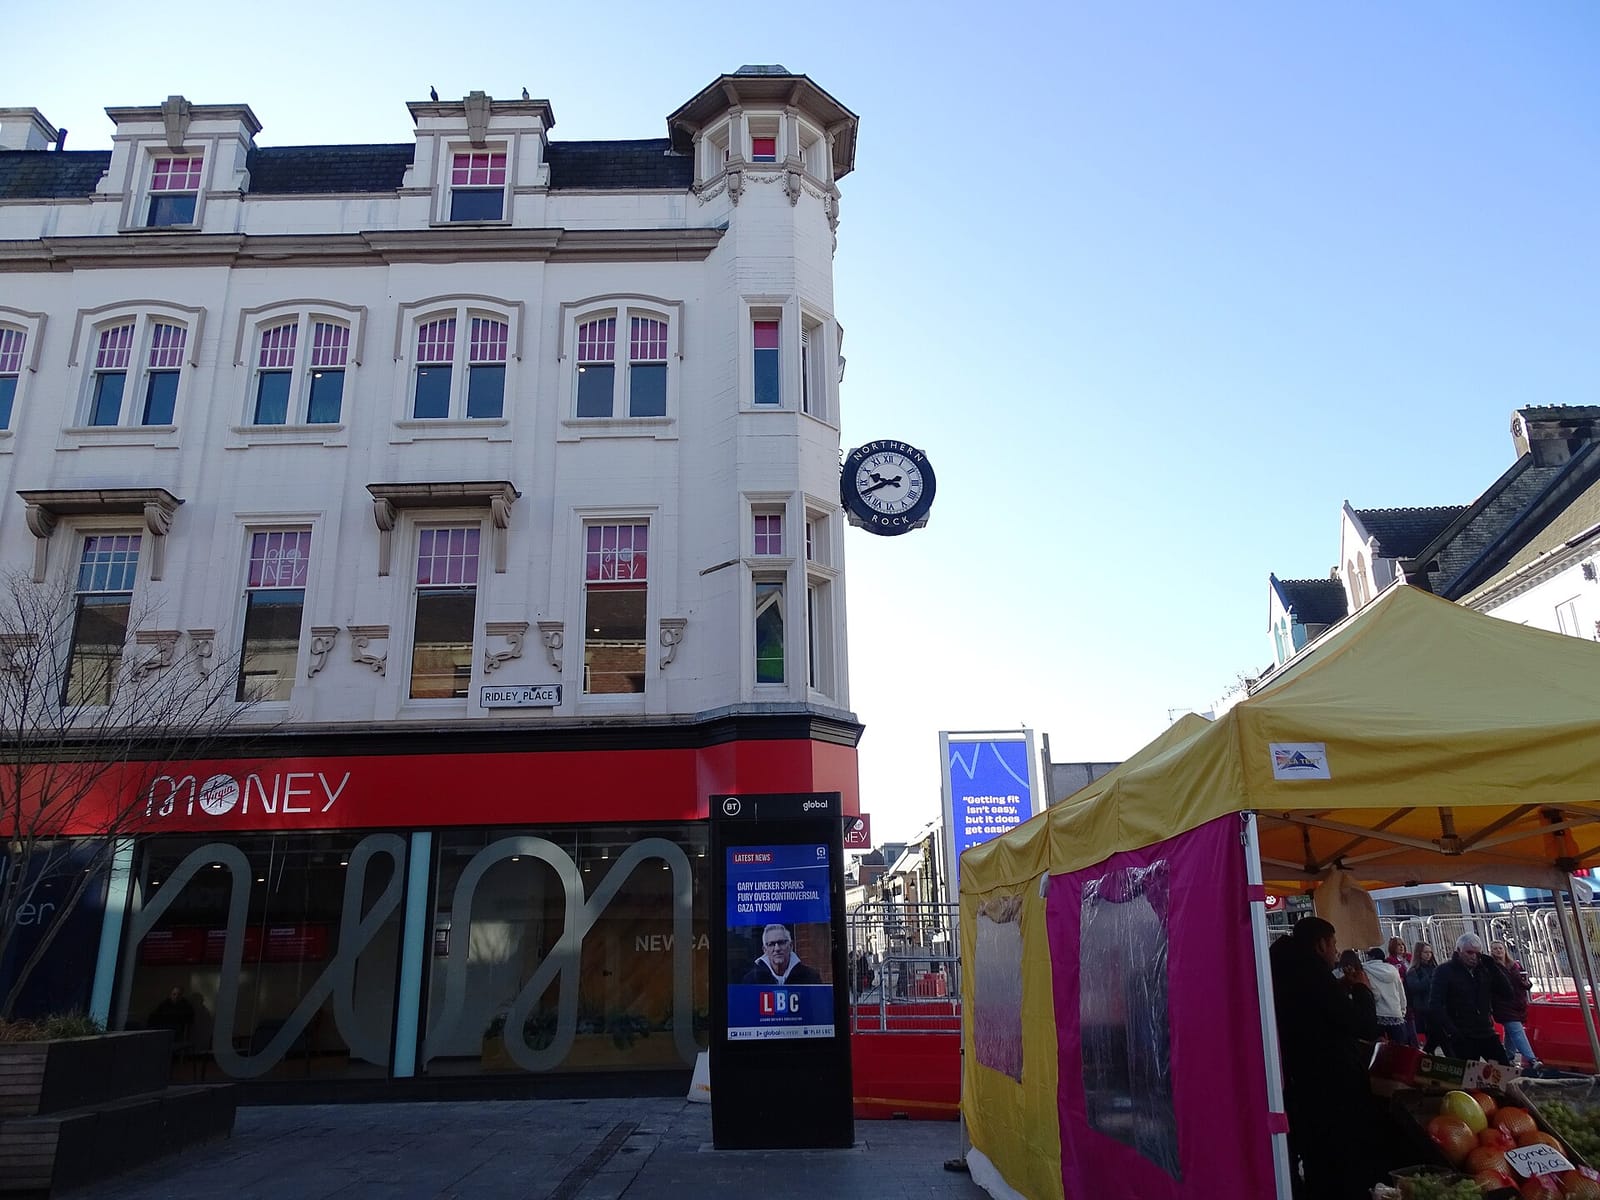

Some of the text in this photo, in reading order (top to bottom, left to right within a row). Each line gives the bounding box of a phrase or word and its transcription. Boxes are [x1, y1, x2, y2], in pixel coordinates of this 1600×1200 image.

[853, 441, 924, 461] NORTHERN
[871, 514, 909, 526] ROCK
[485, 690, 553, 702] RIDLEY PLACE
[203, 781, 236, 808] Virgin
[1007, 795, 1020, 804] fit
[726, 803, 737, 811] BT
[803, 800, 828, 812] global
[991, 806, 1018, 815] easy,
[965, 815, 1021, 824] but it does
[965, 826, 983, 835] get
[734, 853, 771, 862] LATEST NEWS
[737, 880, 805, 891] GARY LINEKER SPARKS
[737, 890, 820, 902] FURY OVER CONTROVERSIAL
[737, 902, 782, 913] GAZA TV SHOW
[763, 992, 799, 1012] LBC
